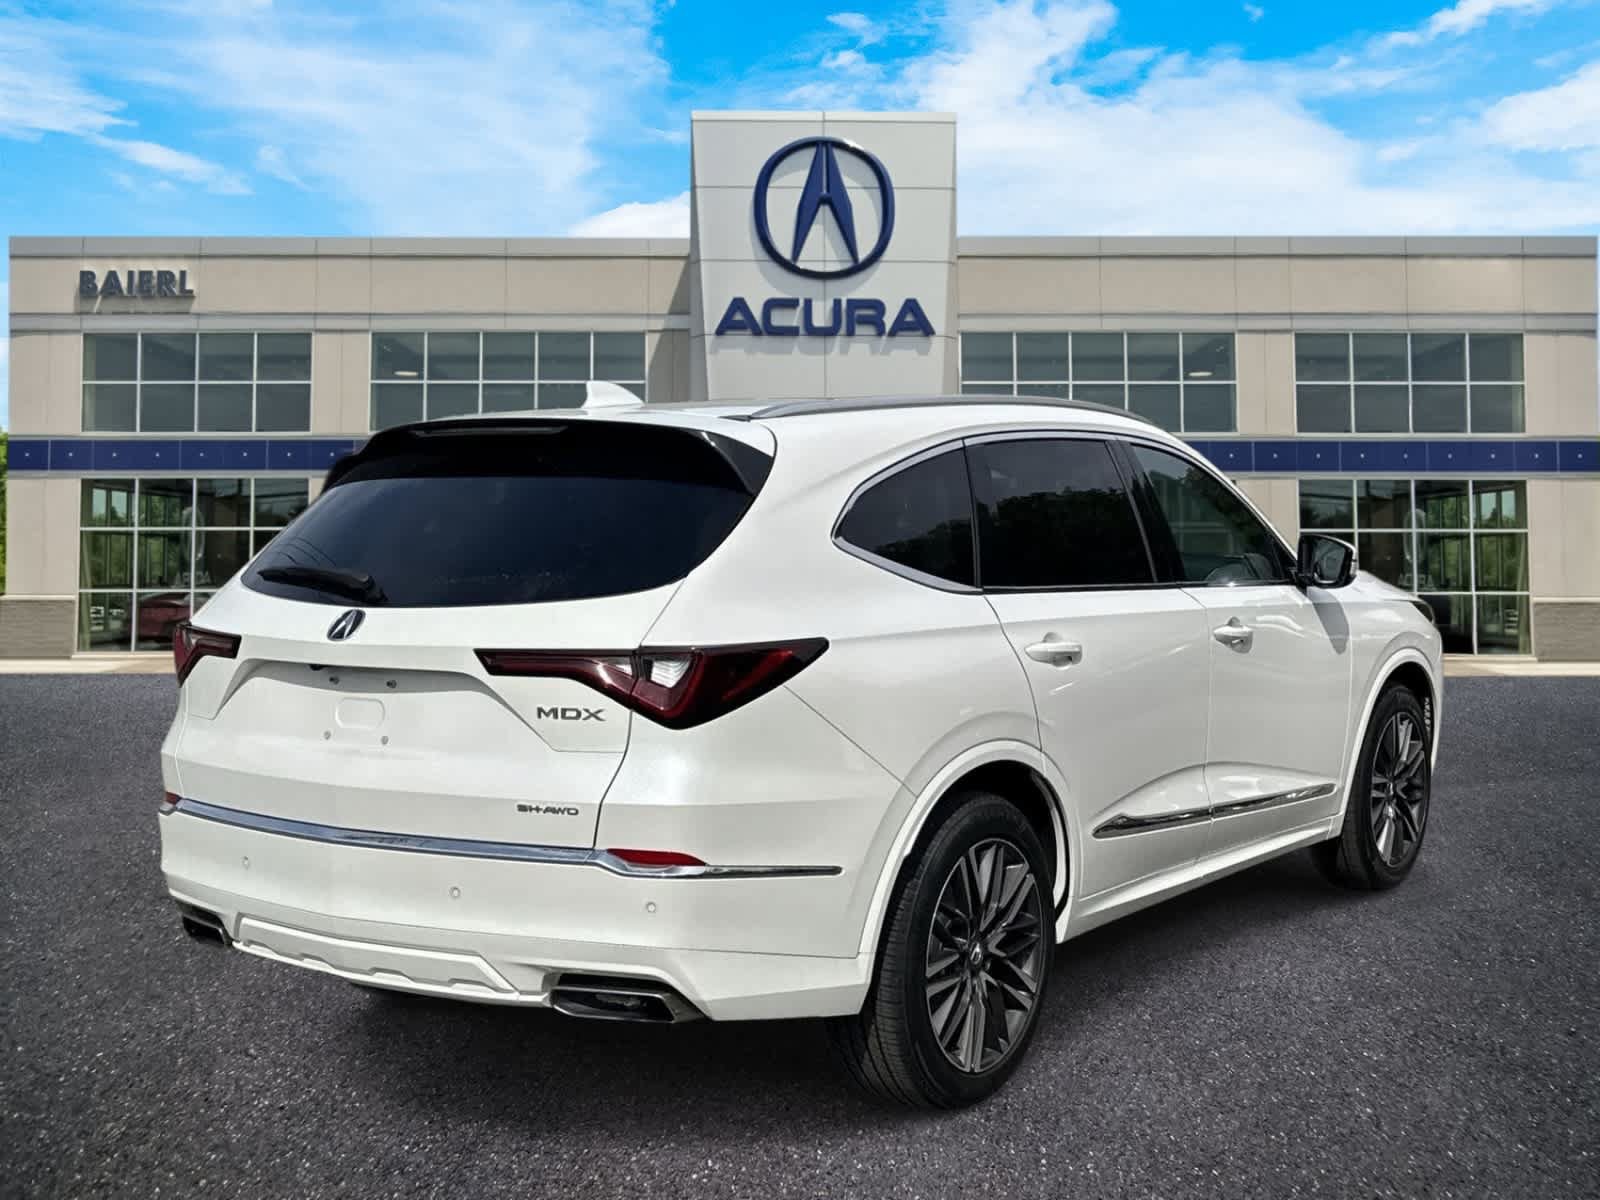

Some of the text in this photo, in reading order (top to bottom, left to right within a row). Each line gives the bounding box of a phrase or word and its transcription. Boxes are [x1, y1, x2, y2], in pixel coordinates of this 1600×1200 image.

[79, 269, 194, 296] BAIERL
[714, 297, 936, 337] ACURA
[536, 706, 606, 721] MDX
[517, 804, 579, 816] SH-AWD
